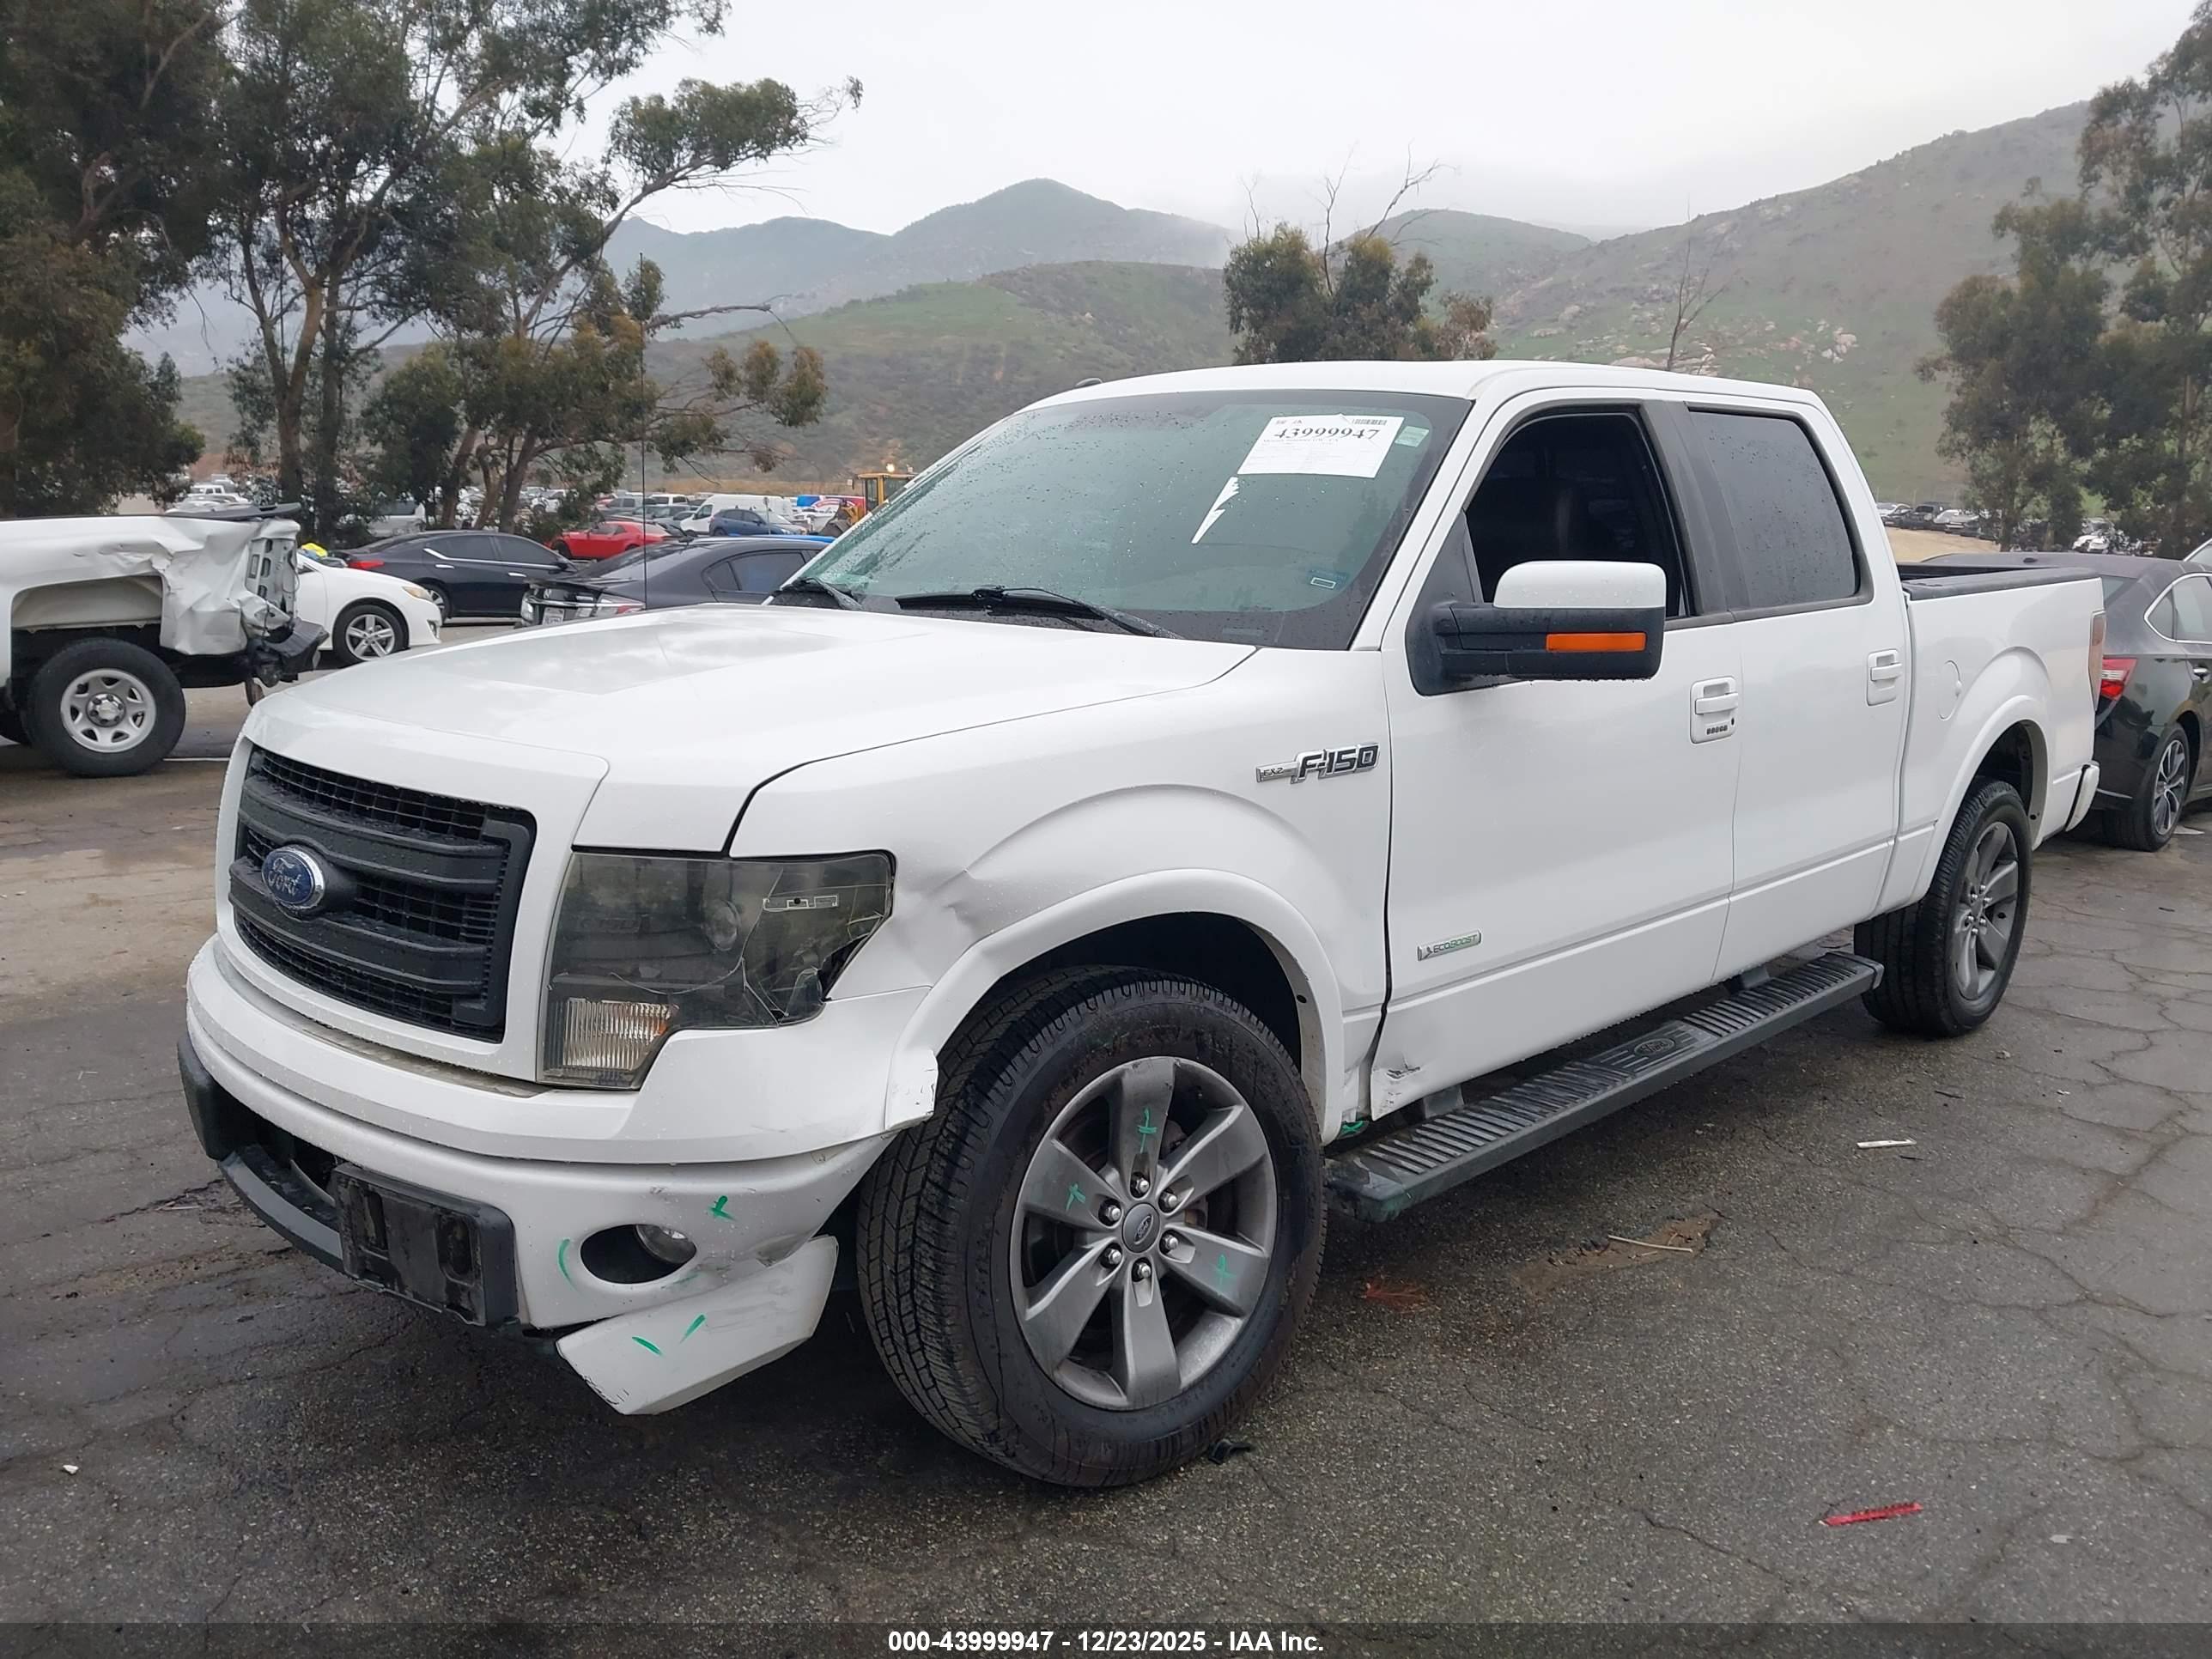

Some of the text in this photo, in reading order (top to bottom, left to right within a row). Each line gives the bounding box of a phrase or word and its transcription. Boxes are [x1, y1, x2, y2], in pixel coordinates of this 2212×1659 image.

[1274, 427, 1382, 440] 43999947
[1292, 743, 1380, 783] F-150
[268, 857, 302, 896] Ford
[1433, 934, 1478, 953] ECOBOOST
